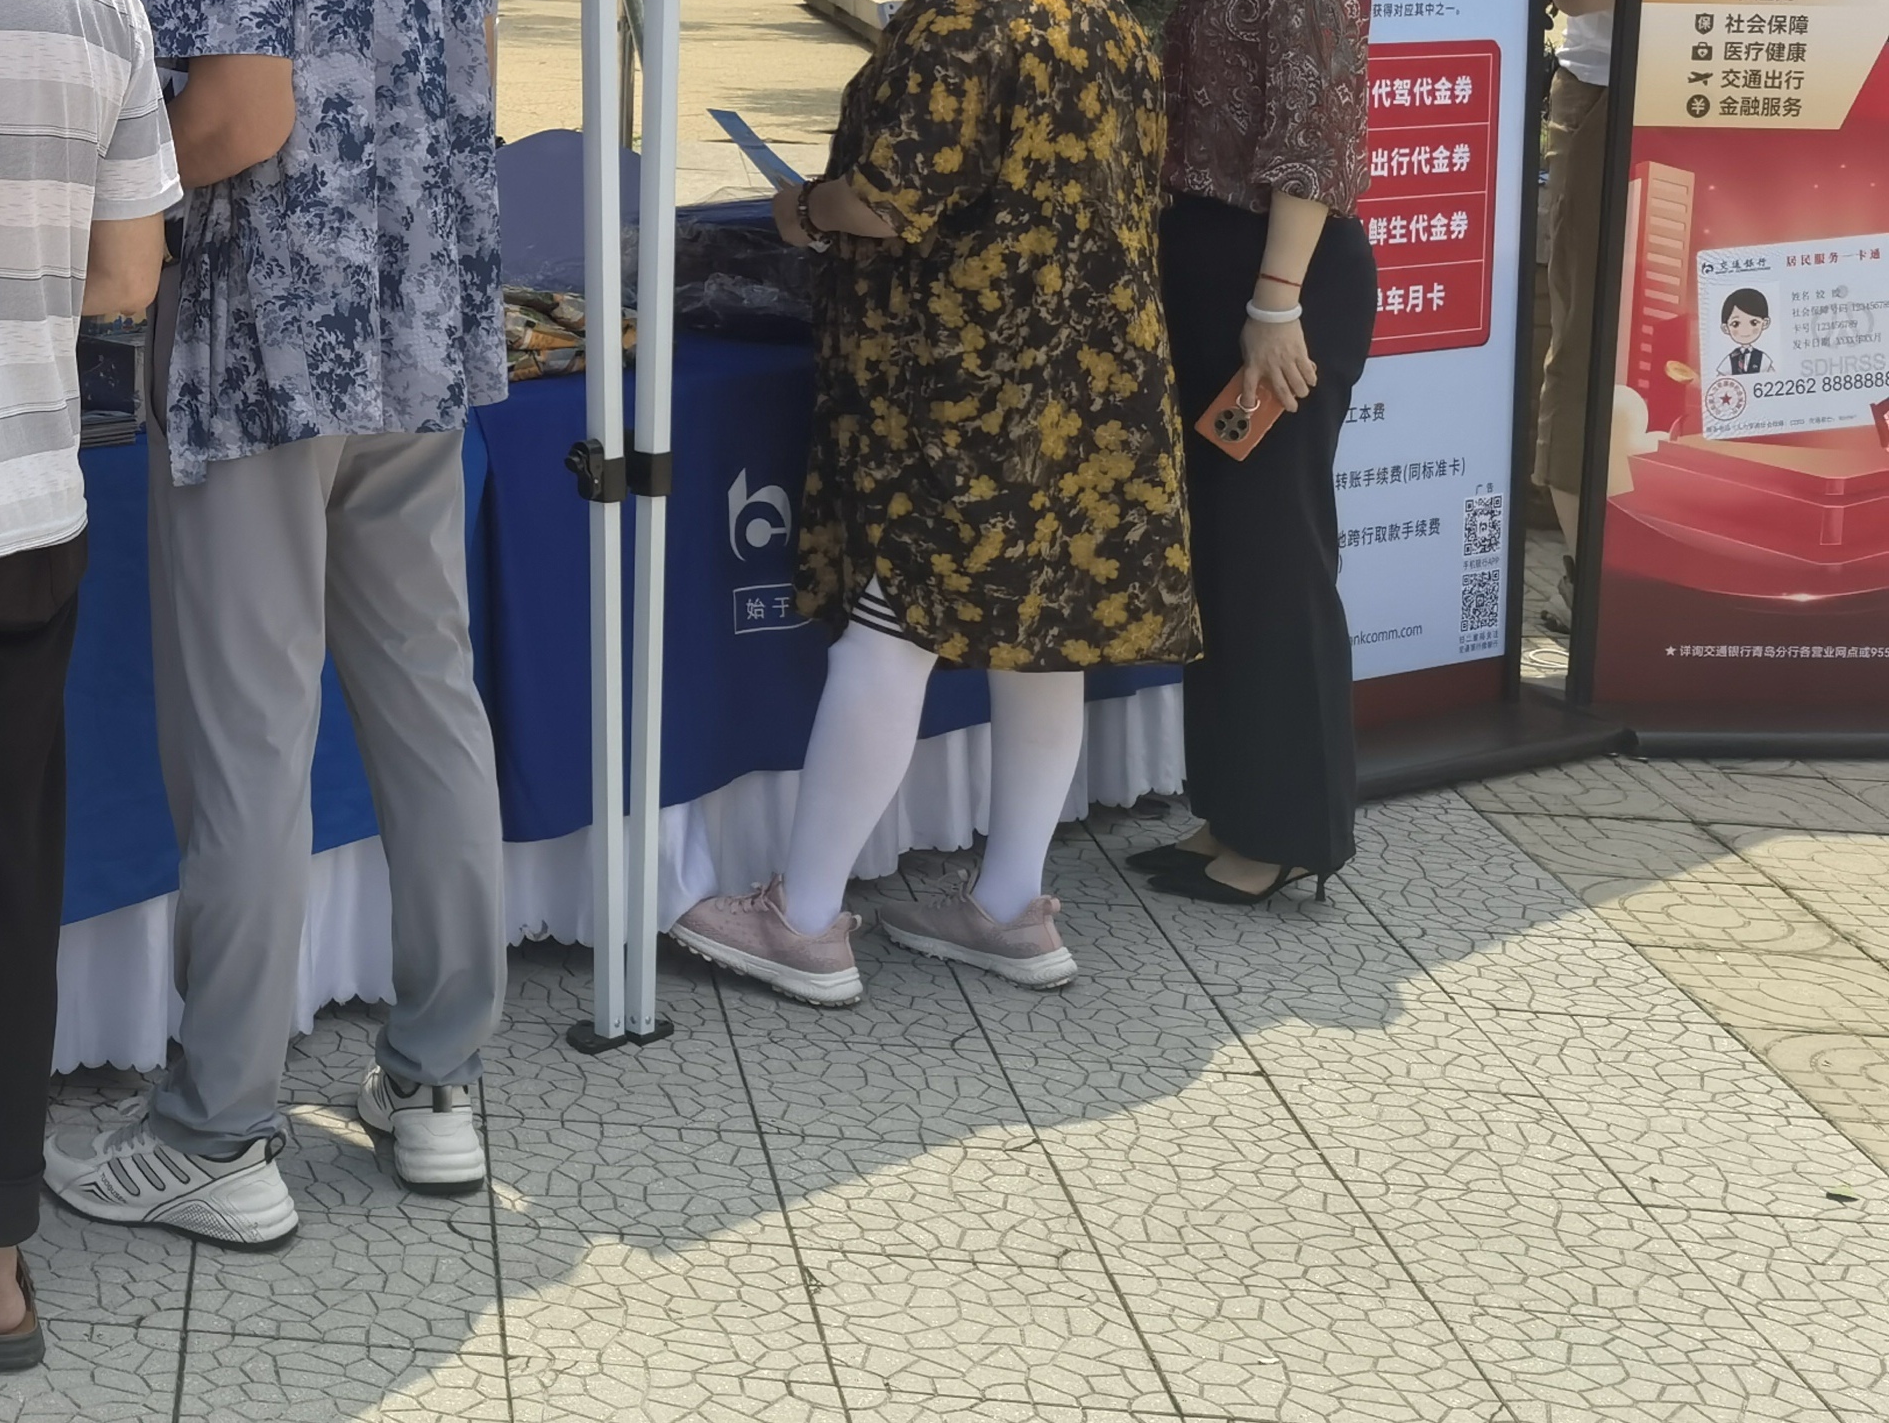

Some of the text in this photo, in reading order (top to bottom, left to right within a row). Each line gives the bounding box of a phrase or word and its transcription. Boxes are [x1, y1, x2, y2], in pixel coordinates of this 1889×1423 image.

[1725, 13, 1809, 35] 社会保障
[1723, 41, 1807, 63] 医疗健康
[1720, 69, 1805, 91] 交通出行
[1367, 75, 1473, 109] 代驾代金券
[1718, 96, 1803, 118] 金融服务
[1800, 353, 1886, 378] SDHRSS
[1753, 377, 1816, 399] 622262
[745, 596, 791, 621] 始于
